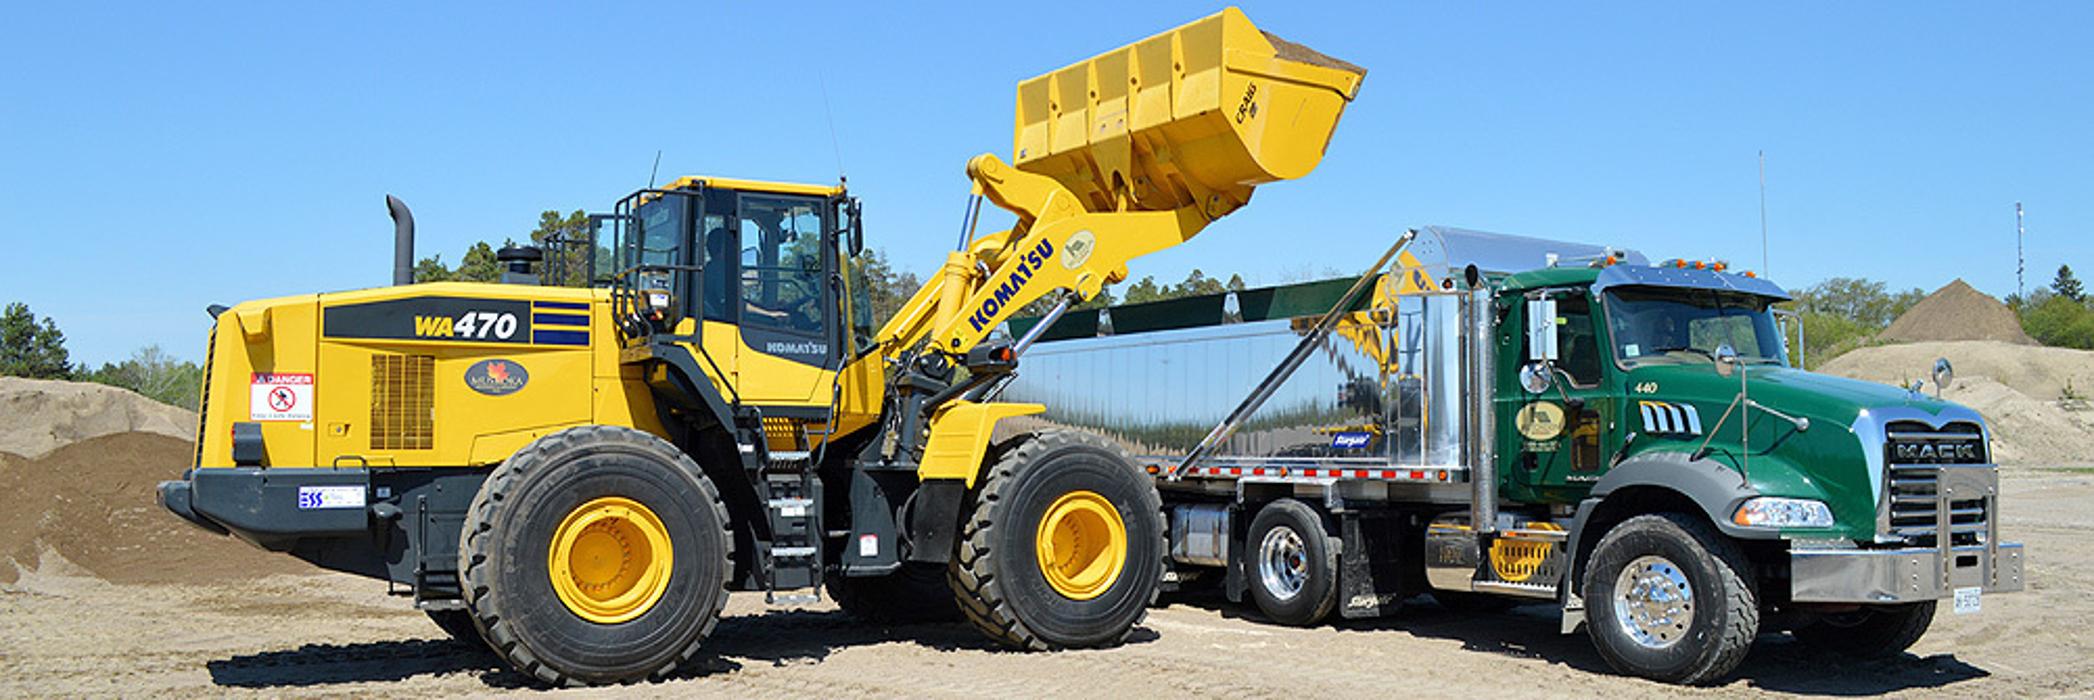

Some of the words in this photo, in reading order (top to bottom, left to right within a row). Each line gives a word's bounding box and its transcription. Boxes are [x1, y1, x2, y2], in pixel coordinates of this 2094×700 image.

[1235, 82, 1257, 124] CRAIG
[968, 238, 1054, 332] KOMATSU
[415, 311, 517, 340] WA470
[766, 341, 828, 354] KOMATSU
[268, 375, 312, 384] DANGER
[1634, 382, 1658, 393] 440
[1897, 444, 1976, 459] MACK
[300, 492, 323, 507] ESS
